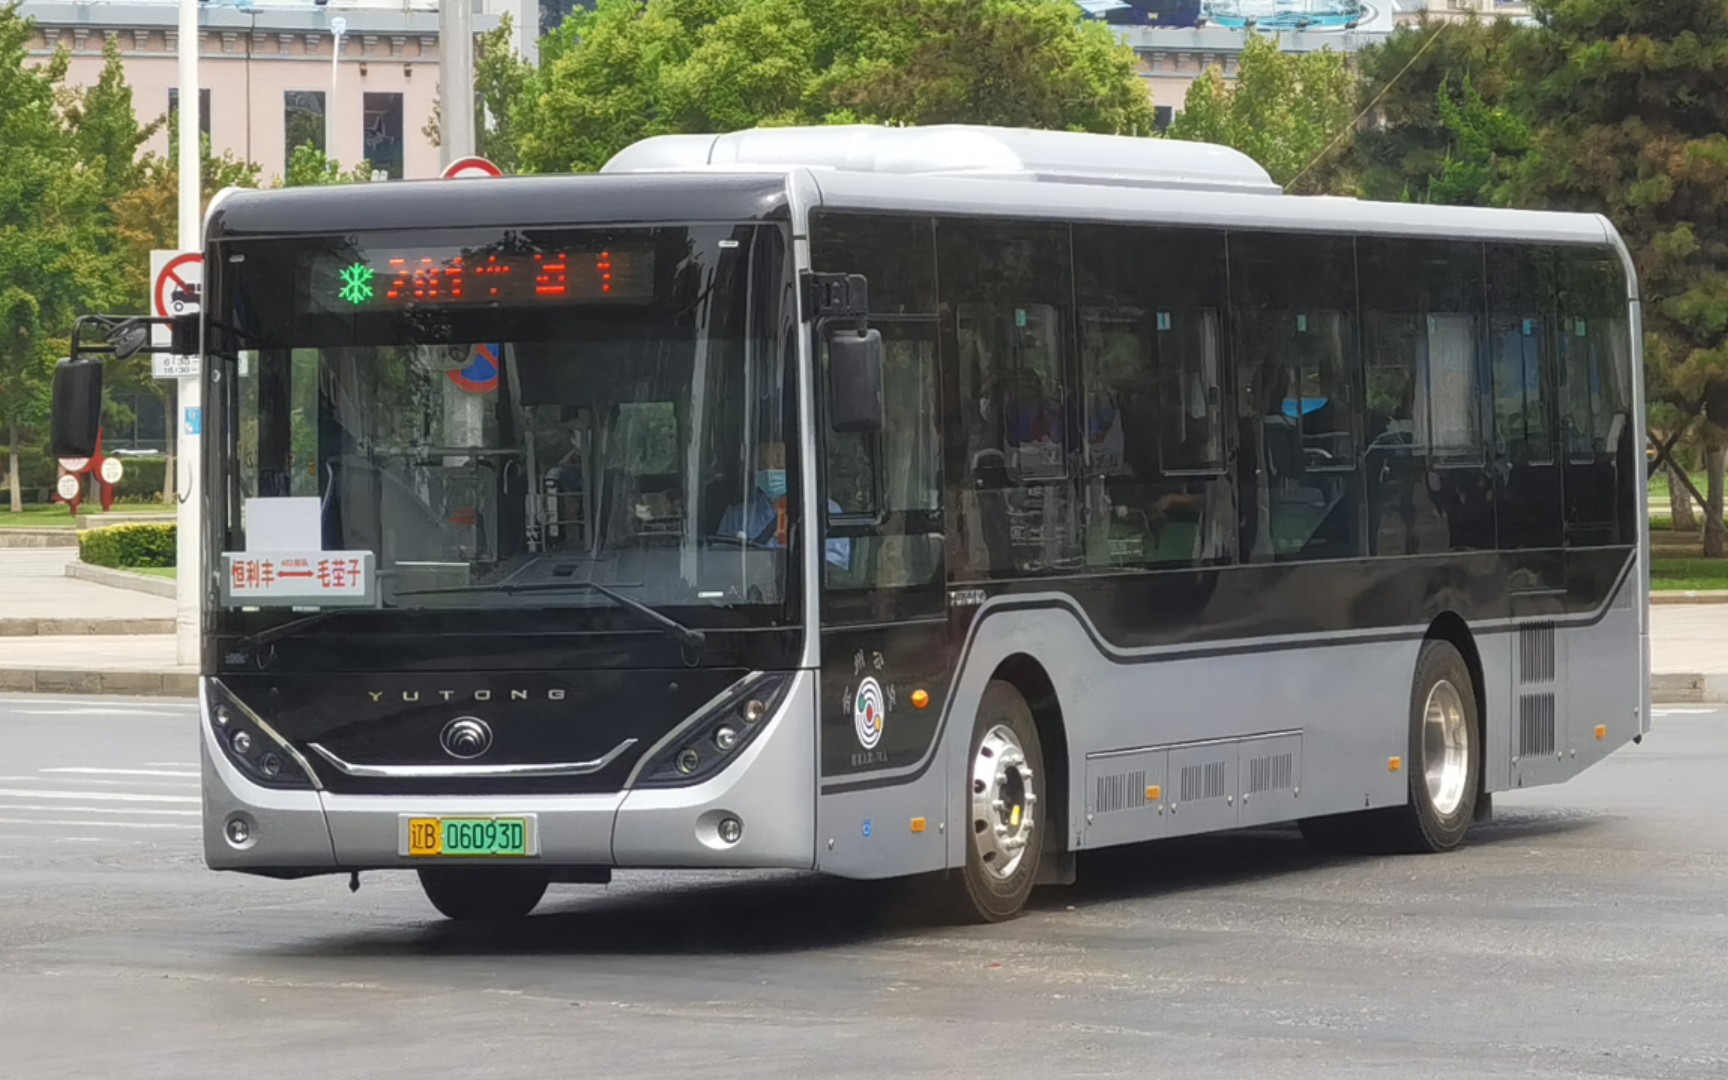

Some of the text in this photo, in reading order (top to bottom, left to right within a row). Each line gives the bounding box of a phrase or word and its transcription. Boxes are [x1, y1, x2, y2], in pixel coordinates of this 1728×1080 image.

[232, 559, 275, 589] 恒利丰
[368, 689, 565, 701] YUTONG
